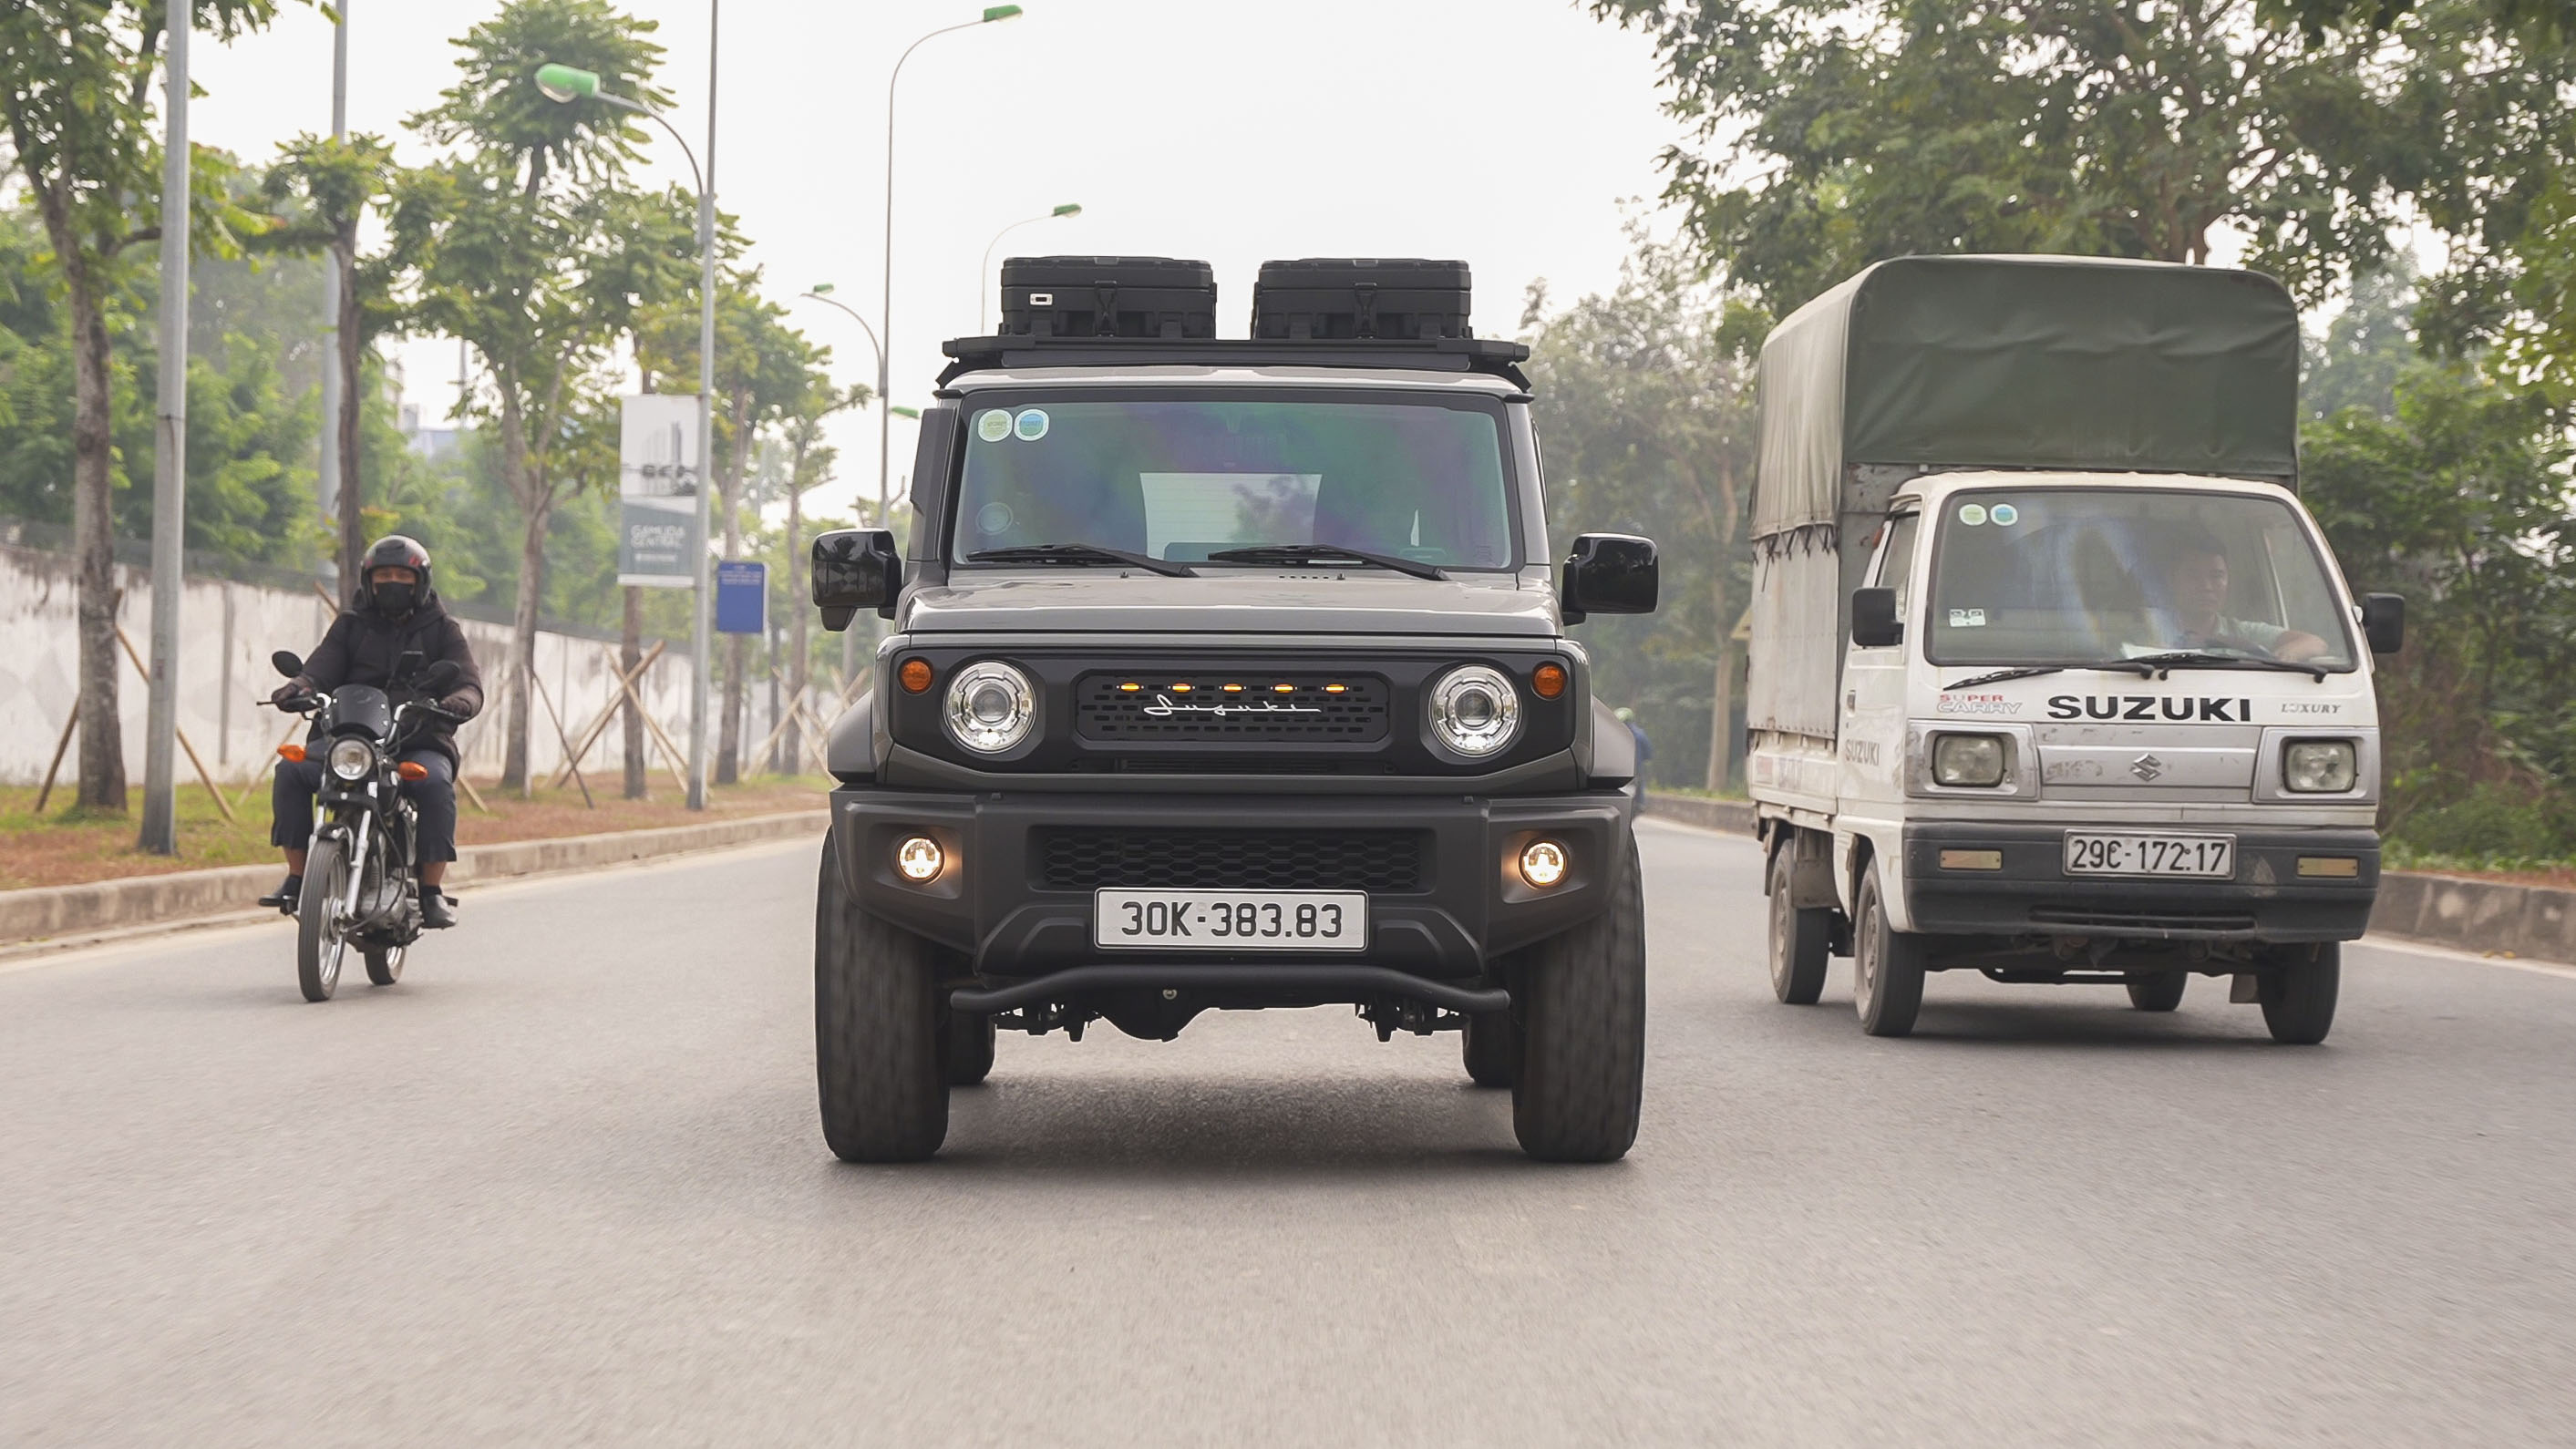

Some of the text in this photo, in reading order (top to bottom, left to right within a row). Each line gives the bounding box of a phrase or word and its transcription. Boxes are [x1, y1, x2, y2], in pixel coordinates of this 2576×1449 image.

[1936, 701, 2023, 714] CARRY
[2047, 695, 2251, 722] SUZUKI
[2281, 703, 2342, 714] LUXURY
[1845, 738, 1880, 766] SUZUKI
[2071, 838, 2227, 872] 29C-172.17
[1121, 901, 1342, 939] 30K-383.83
